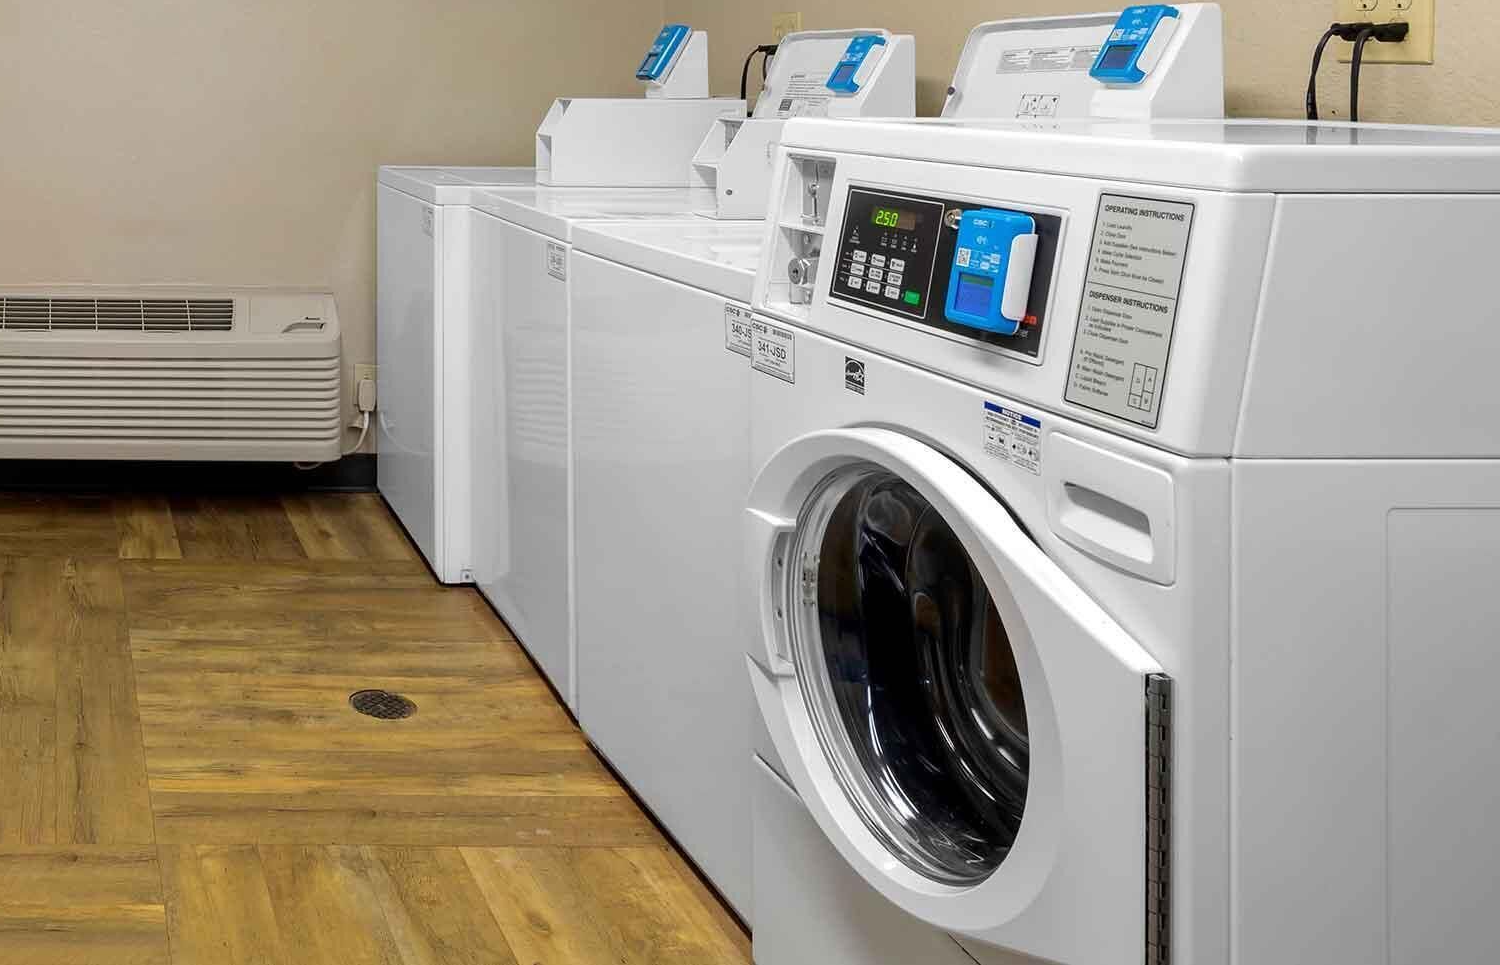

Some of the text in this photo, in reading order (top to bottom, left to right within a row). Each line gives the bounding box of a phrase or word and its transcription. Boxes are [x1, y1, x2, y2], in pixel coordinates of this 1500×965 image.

[1105, 204, 1186, 222] OPERATING INSTRUCTIONS
[1089, 291, 1122, 303] DISPENSER
[1123, 297, 1169, 314] INSTRUCTIONS
[758, 341, 787, 359] 341-JSD
